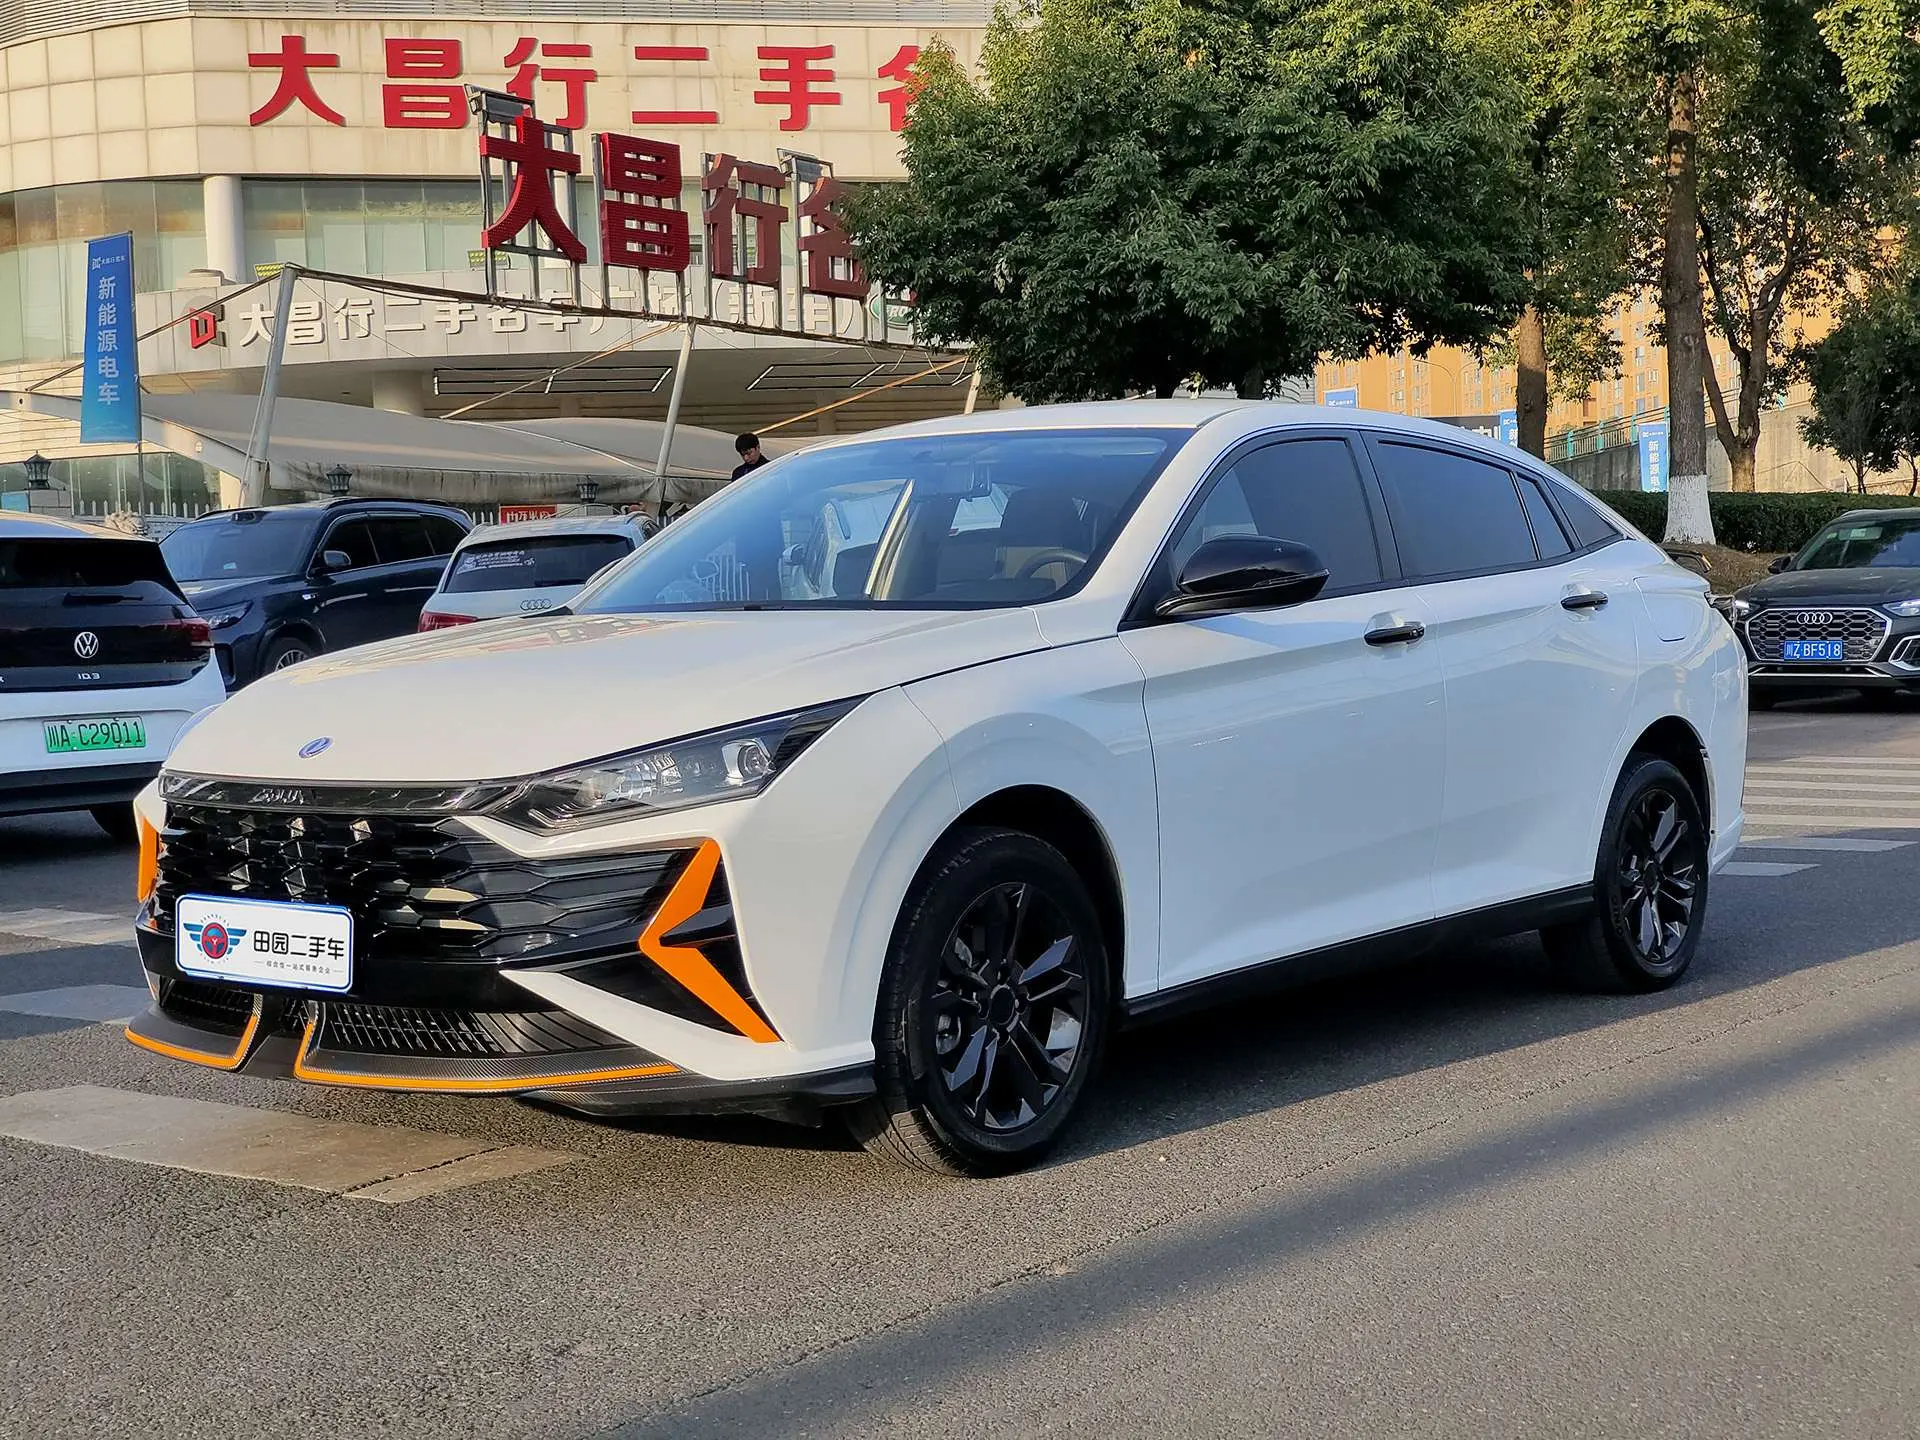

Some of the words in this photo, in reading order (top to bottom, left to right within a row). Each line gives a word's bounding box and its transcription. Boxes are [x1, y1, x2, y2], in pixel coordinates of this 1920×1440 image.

[97, 275, 121, 405] 新能源电车
[253, 930, 345, 960] 田园二手车
